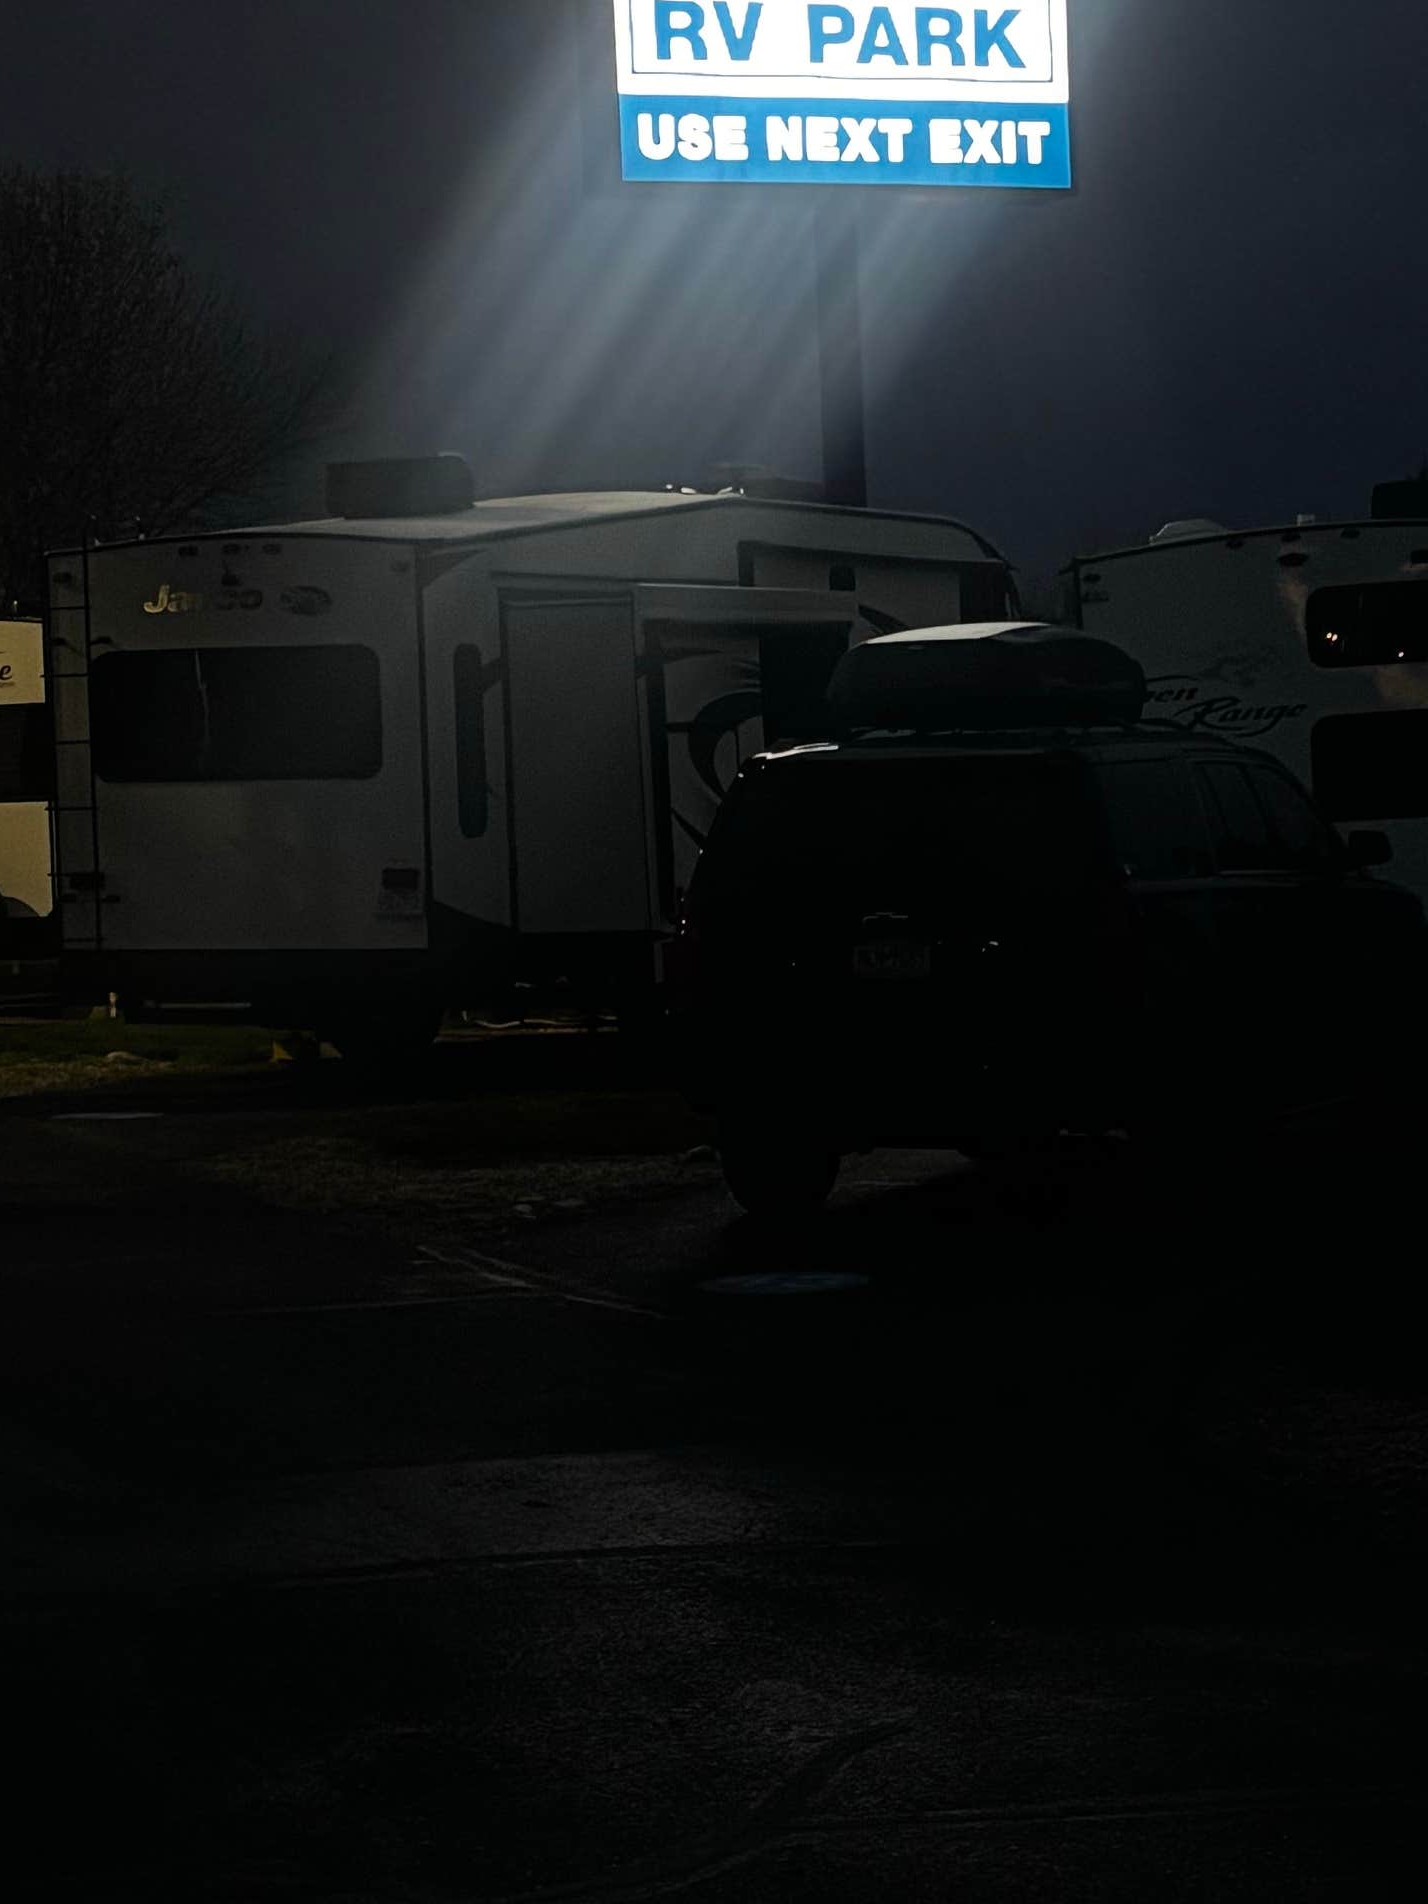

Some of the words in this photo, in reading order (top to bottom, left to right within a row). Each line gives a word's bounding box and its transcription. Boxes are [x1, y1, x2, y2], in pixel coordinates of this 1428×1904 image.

[806, 3, 1027, 69] PARK
[636, 112, 749, 162] USE
[765, 115, 913, 164] NEXT
[928, 119, 1051, 165] EXIT
[1174, 696, 1308, 737] Range
